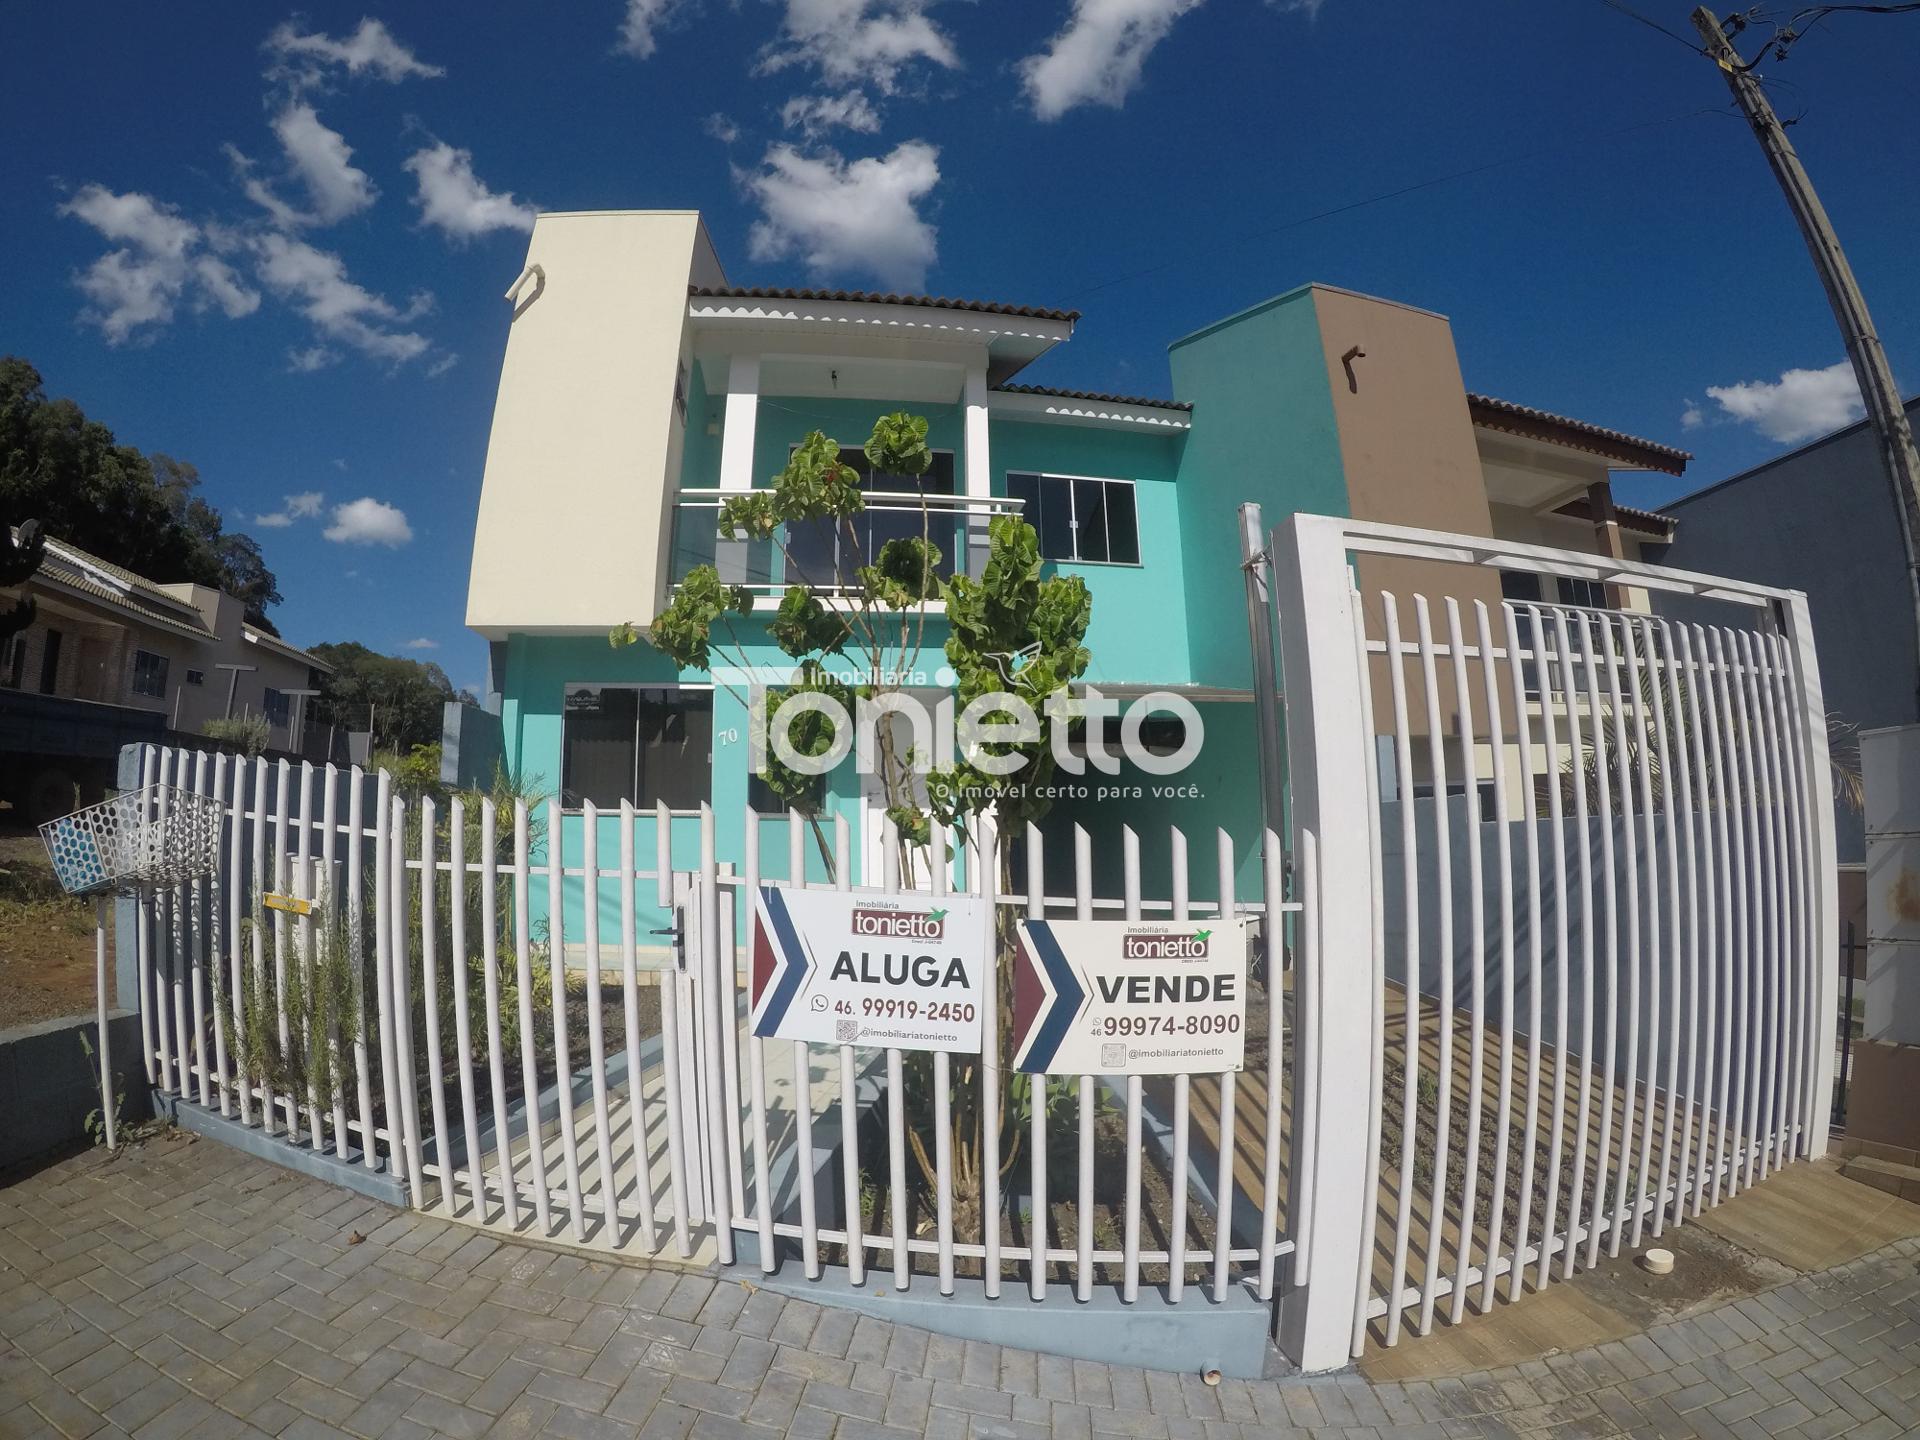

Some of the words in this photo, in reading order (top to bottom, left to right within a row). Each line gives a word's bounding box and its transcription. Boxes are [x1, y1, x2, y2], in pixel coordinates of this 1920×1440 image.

[718, 728, 738, 746] 70
[856, 900, 900, 910] Imobiliária
[855, 911, 941, 938] tonietto
[1127, 926, 1169, 934] Imobiliária
[1127, 936, 1206, 957] tonietto
[830, 950, 970, 989] ALUGA
[1096, 974, 1235, 1004] VENDE
[834, 999, 856, 1016] 46.
[862, 997, 975, 1023] 99919-2450
[861, 1026, 958, 1042] @imobiliariatonietto
[1090, 1028, 1102, 1037] 46
[1104, 1014, 1240, 1036] 99974-8090
[1128, 1047, 1224, 1060] @imobiliariatonietto
